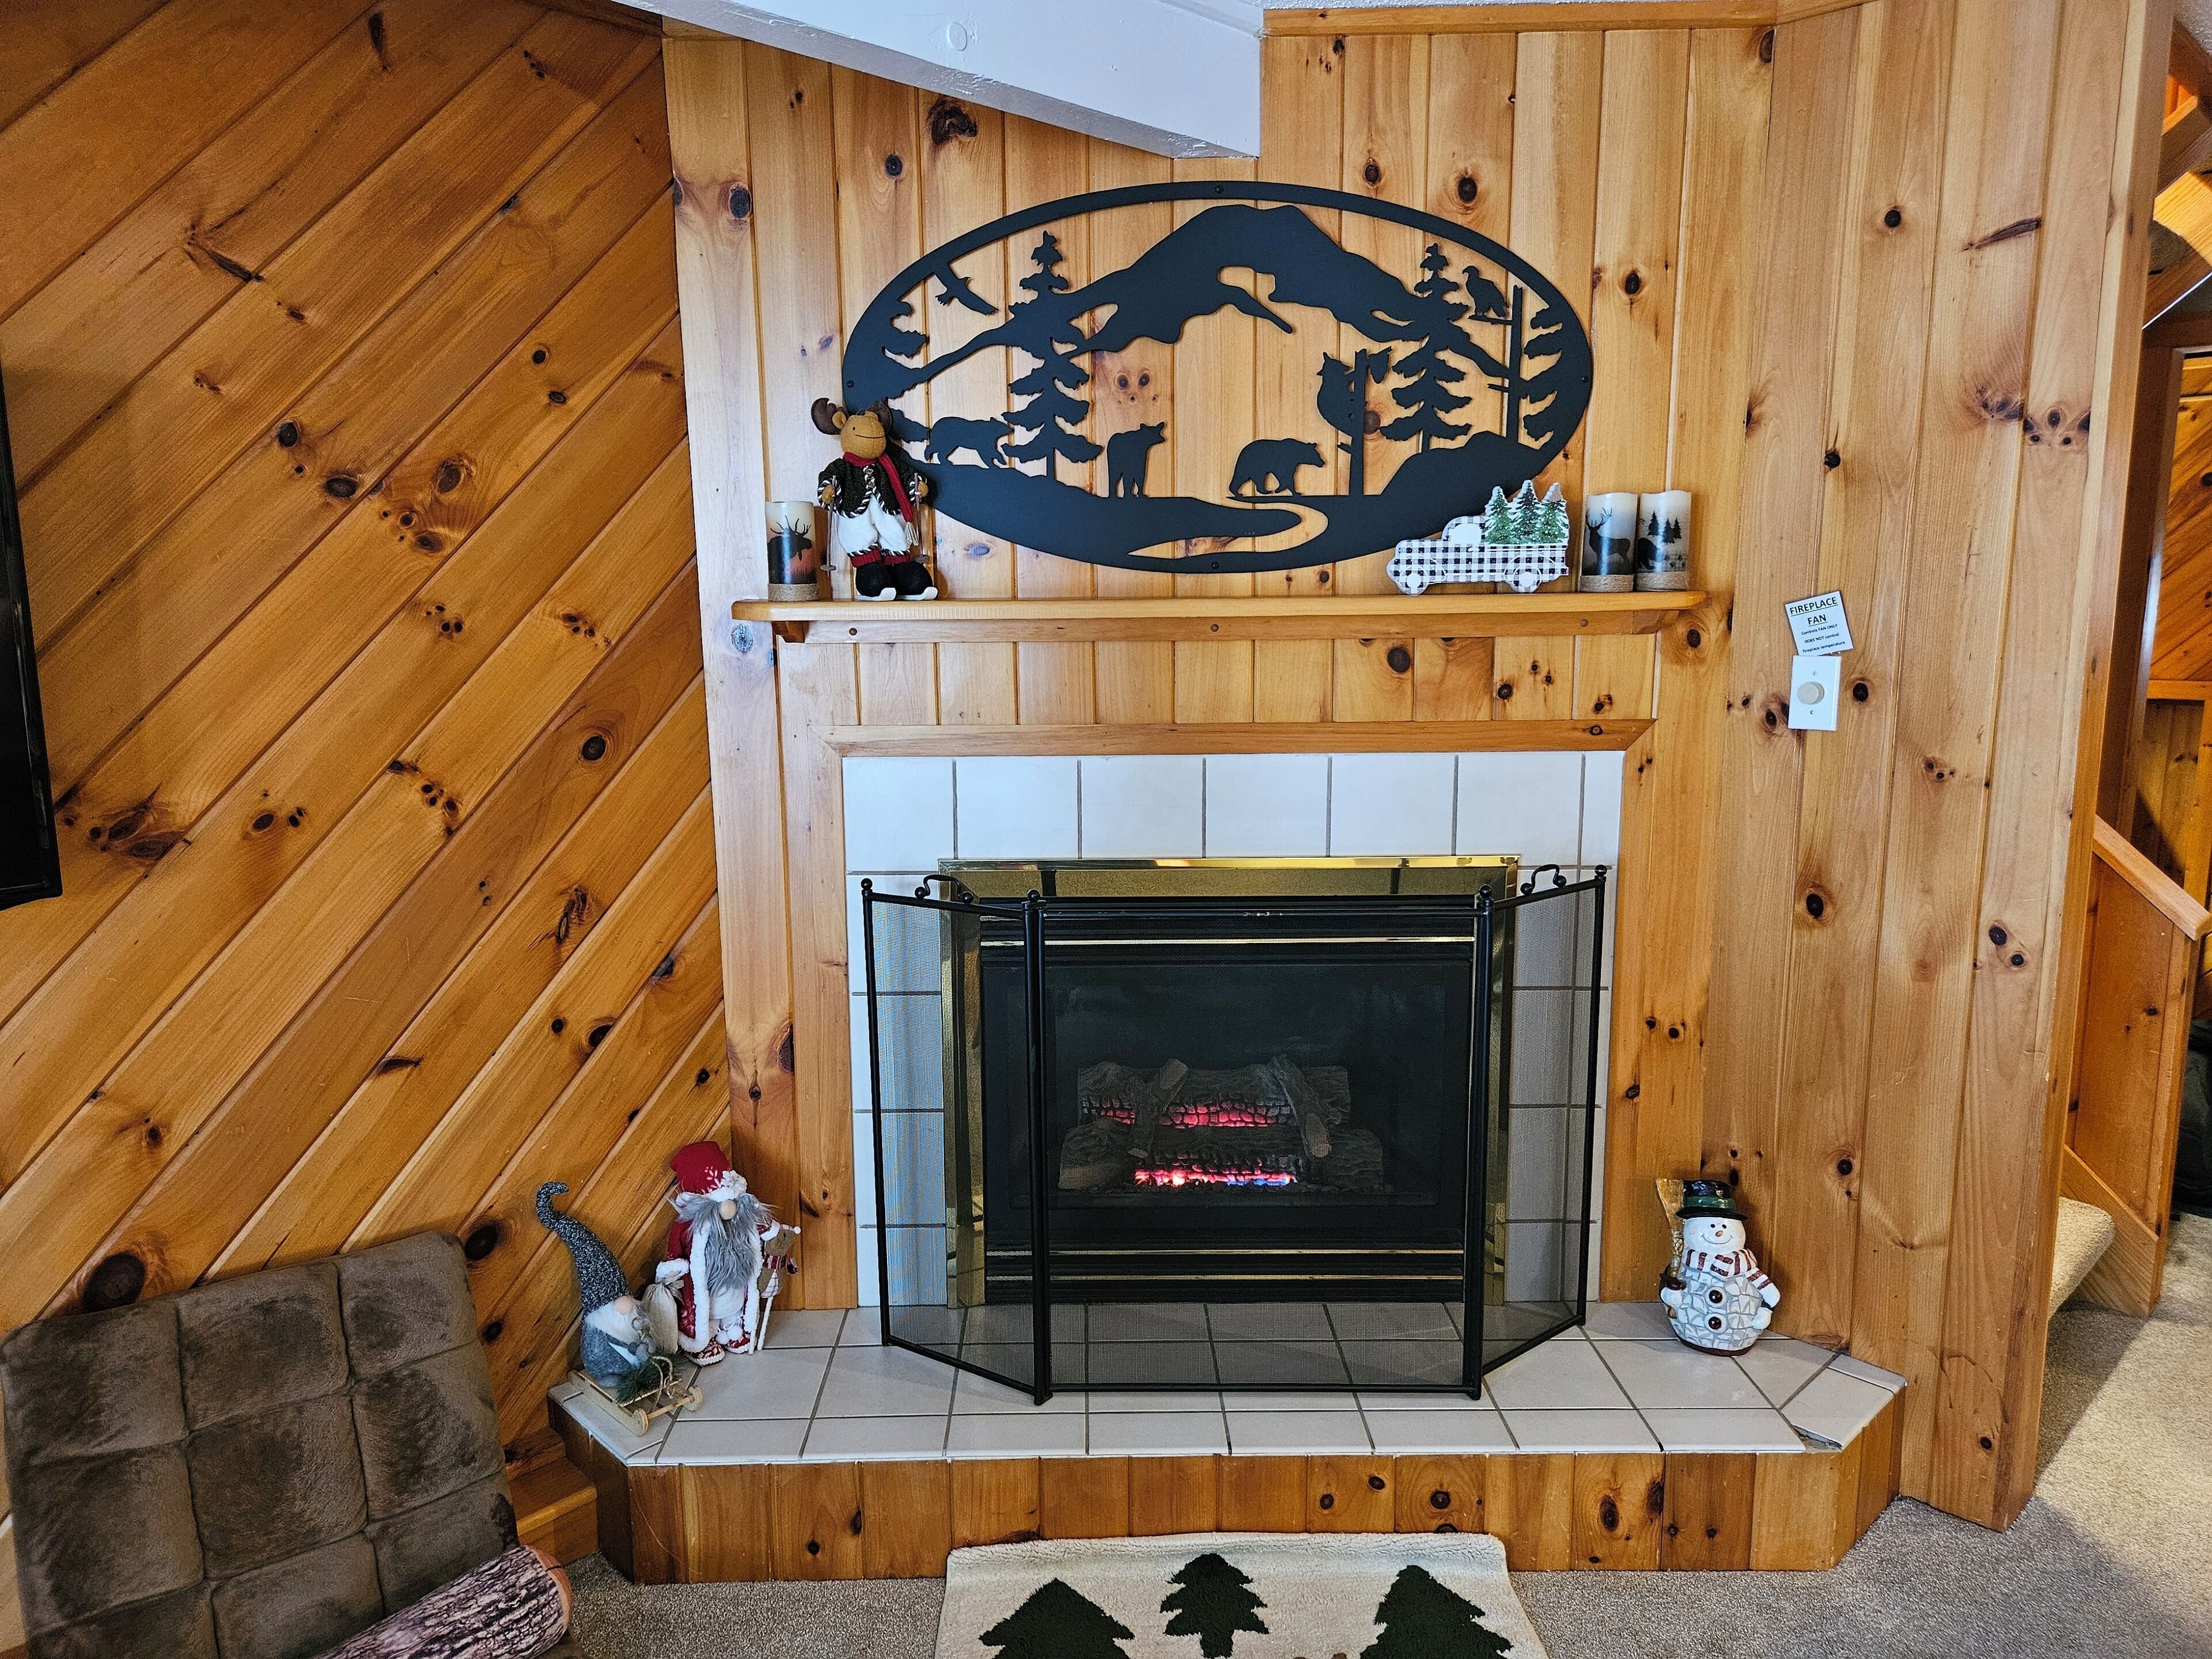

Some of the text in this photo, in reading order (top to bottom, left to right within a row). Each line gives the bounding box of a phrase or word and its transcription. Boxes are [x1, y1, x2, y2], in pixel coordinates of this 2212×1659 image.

[1790, 597, 1838, 615] FIREPLACE
[1808, 614, 1827, 625] FAN
[1820, 641, 1846, 649] temperature
